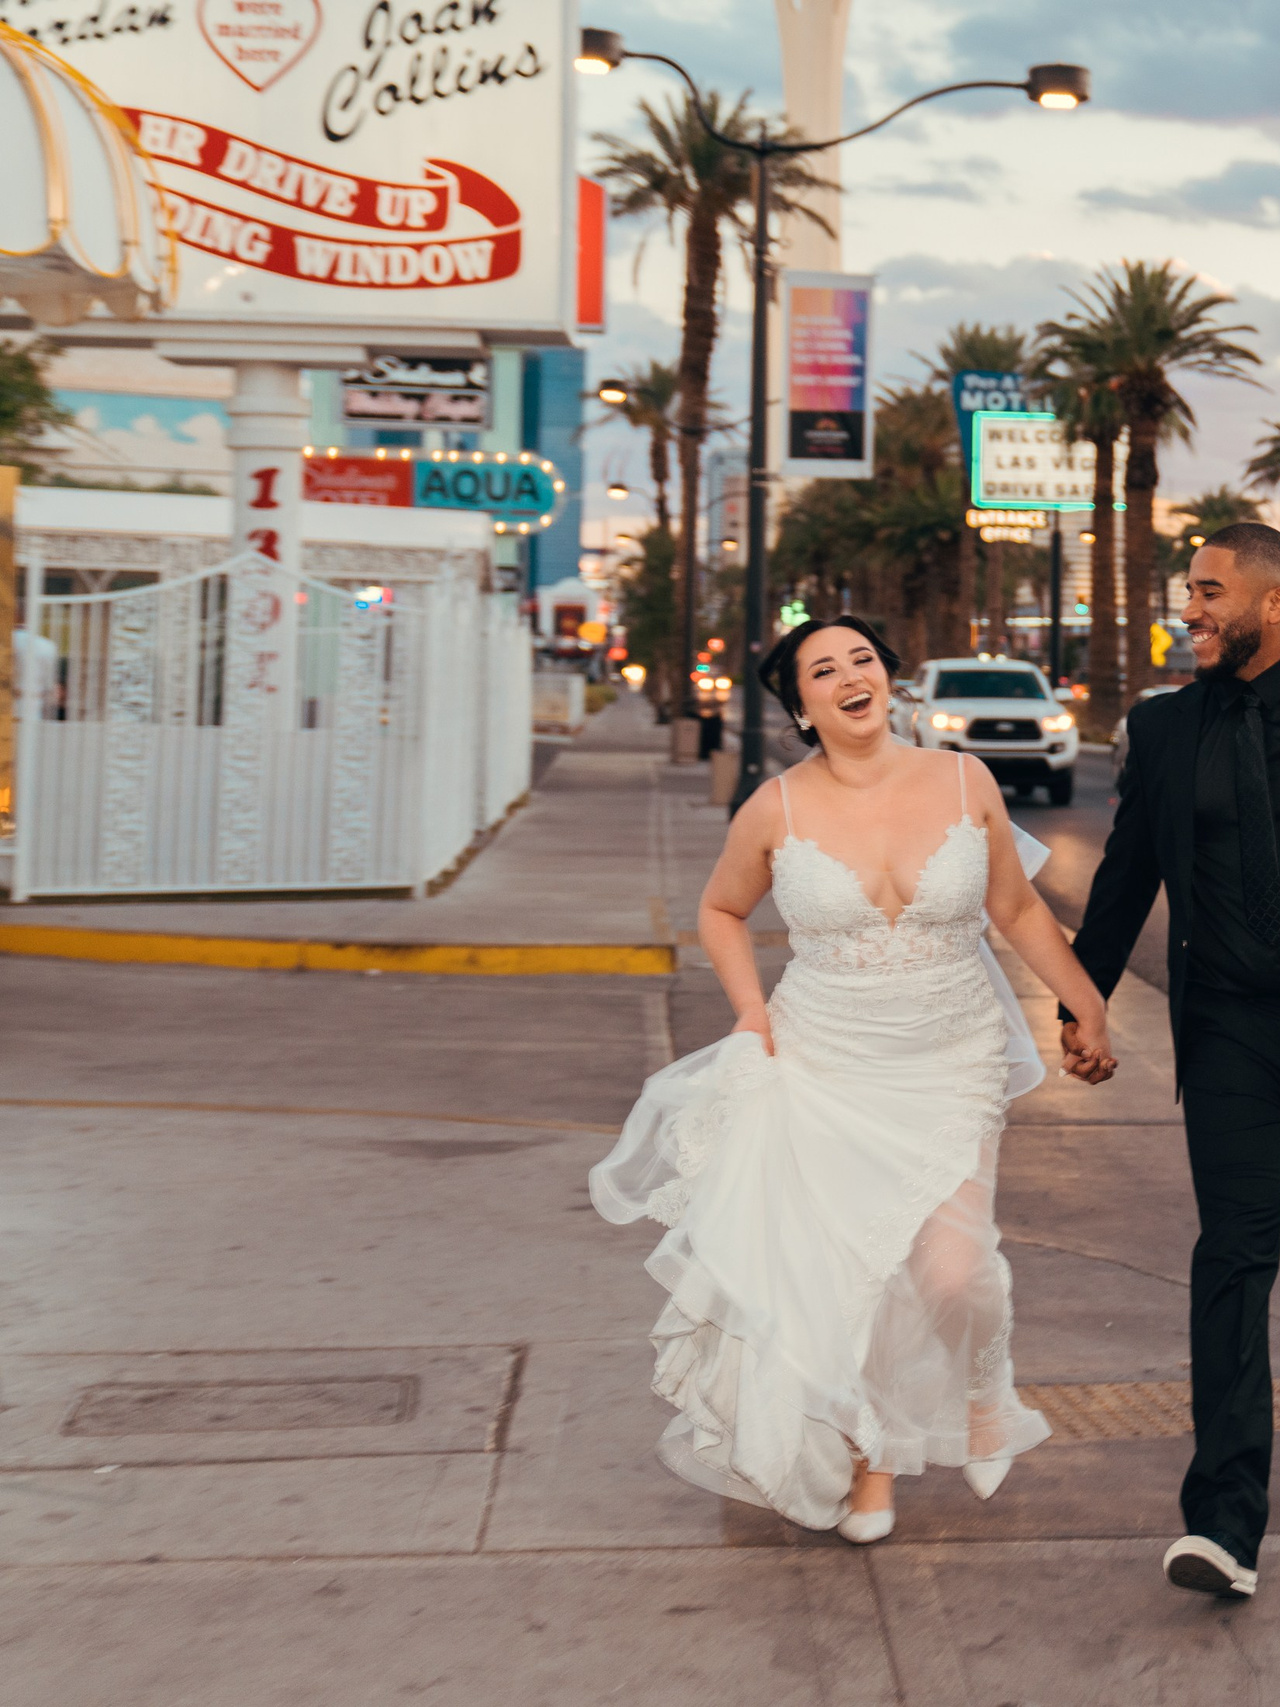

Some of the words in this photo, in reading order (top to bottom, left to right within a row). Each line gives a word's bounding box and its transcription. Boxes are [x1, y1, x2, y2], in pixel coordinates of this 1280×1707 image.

[363, 0, 500, 80] Joan
[321, 42, 543, 142] Collins
[217, 137, 360, 218] DRIVE
[375, 185, 439, 228] UP
[293, 235, 496, 286] WINDOW
[421, 468, 541, 506] AQUA
[996, 456, 1037, 470] LAS
